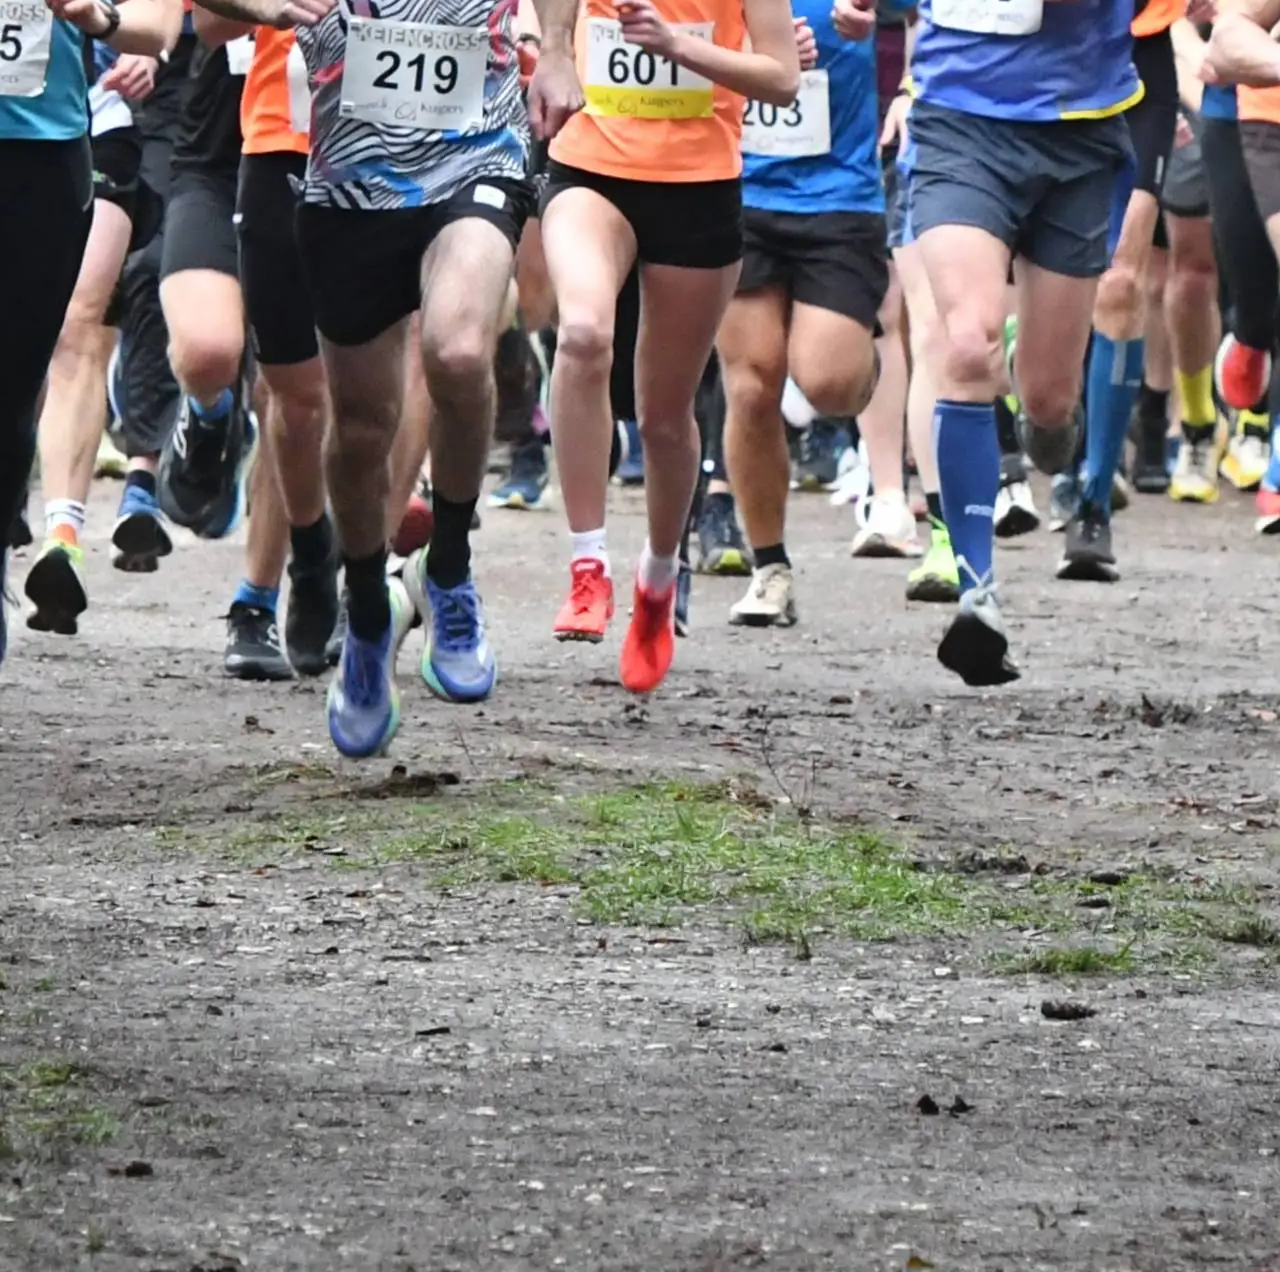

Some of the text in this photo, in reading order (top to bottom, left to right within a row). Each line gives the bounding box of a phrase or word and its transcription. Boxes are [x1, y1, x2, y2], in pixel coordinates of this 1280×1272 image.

[372, 50, 459, 94] 219
[608, 47, 678, 86] 601
[742, 97, 803, 128] 203
